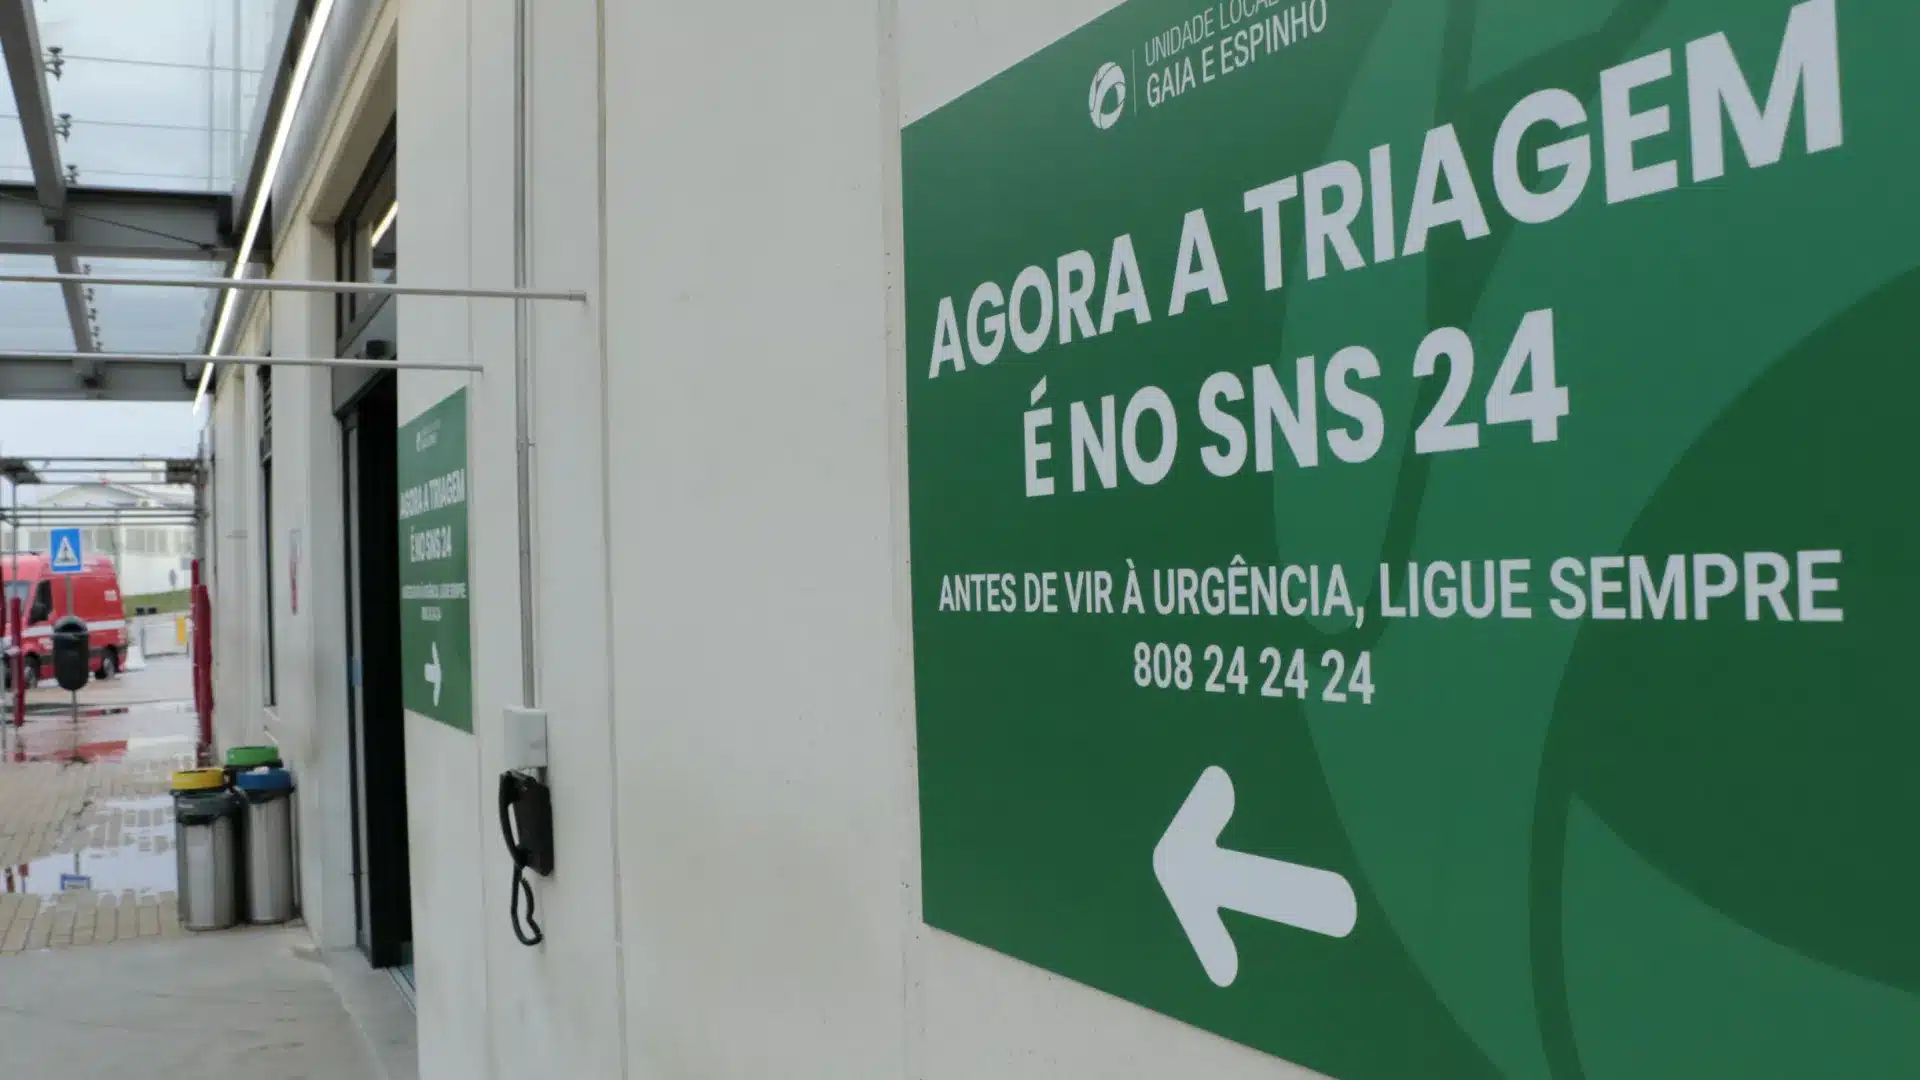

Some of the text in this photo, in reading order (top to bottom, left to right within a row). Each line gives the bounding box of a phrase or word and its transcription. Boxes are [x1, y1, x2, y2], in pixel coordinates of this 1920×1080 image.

[1145, 7, 1215, 66] UNIDADE
[1146, 0, 1327, 107] GAIA E ESPINHO
[928, 0, 1843, 379] AGORA A TRIAGEM
[1023, 308, 1570, 498] É NO SNS 24
[938, 549, 1843, 629] ANTES DE VIR À URGÊNCIA, LIGUE SEMPRE
[1134, 641, 1375, 704] 808 24 24 24
